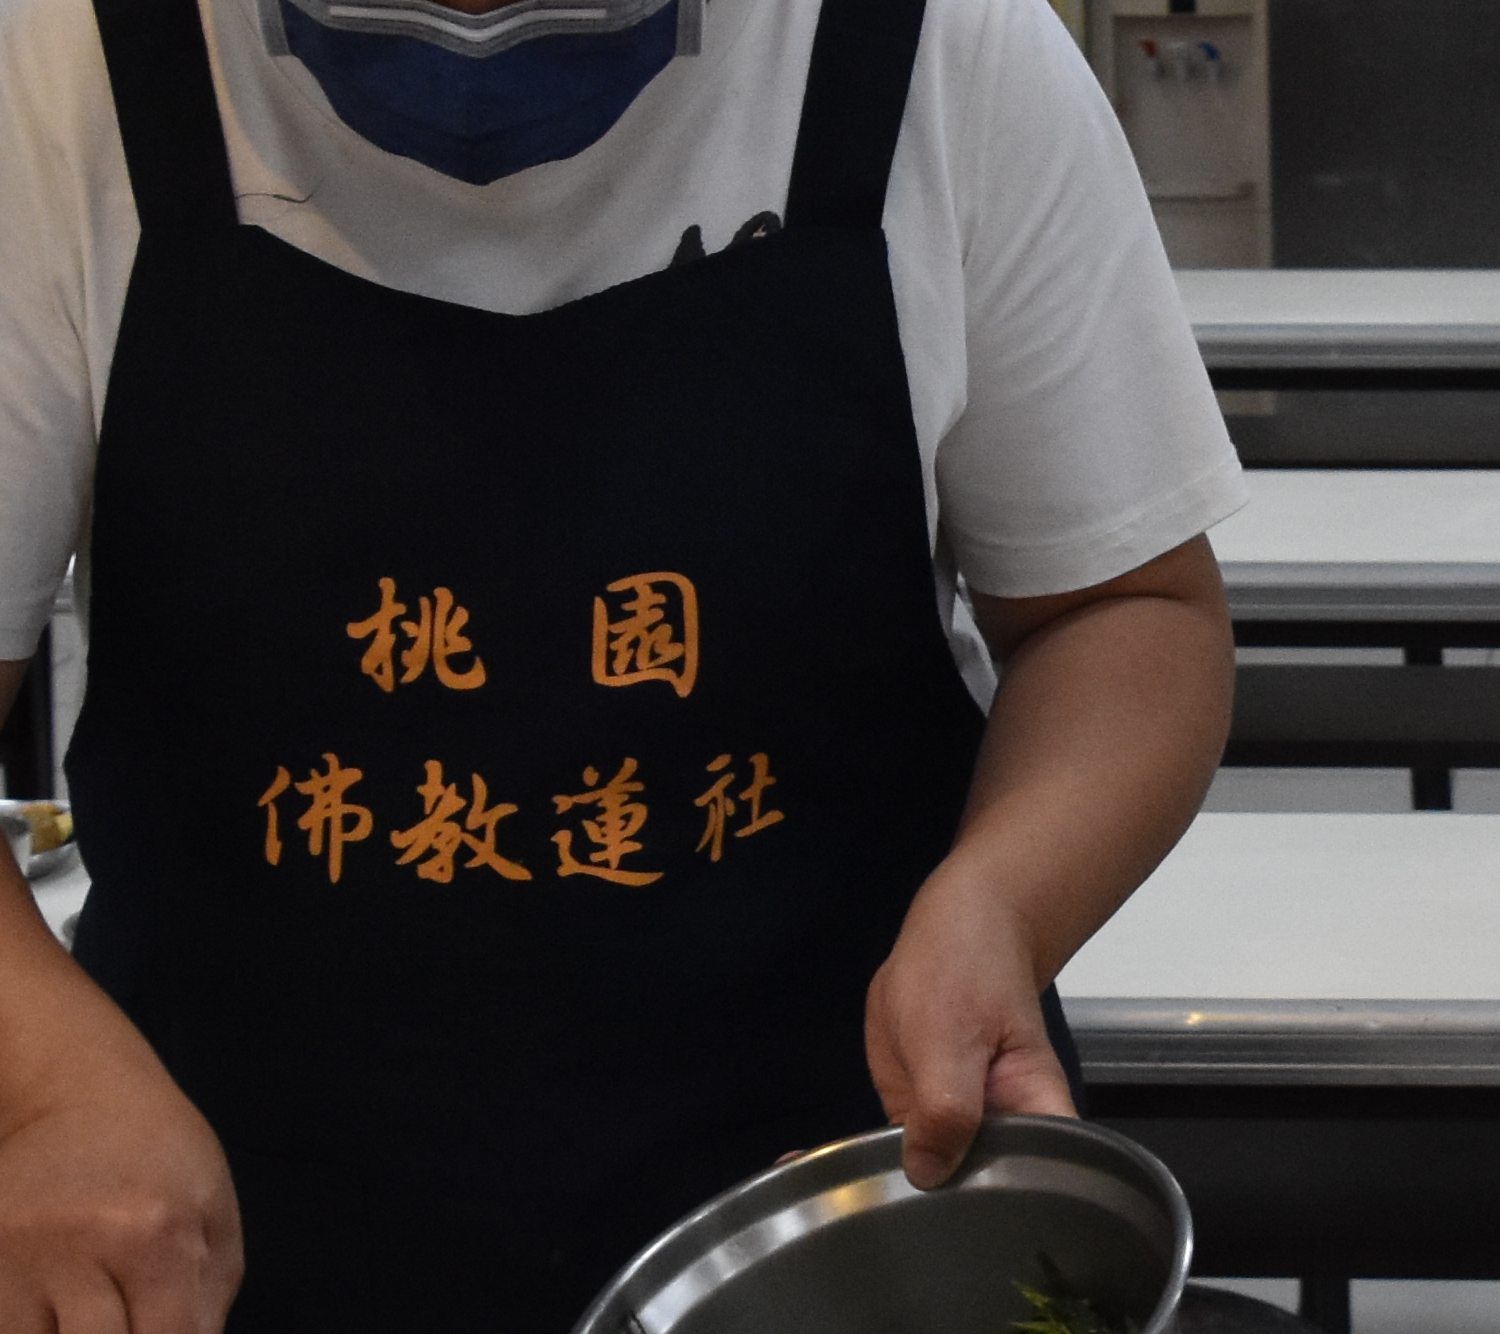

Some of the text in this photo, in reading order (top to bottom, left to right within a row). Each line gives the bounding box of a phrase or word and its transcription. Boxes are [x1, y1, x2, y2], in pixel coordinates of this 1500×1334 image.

[346, 570, 699, 699] 桃園
[257, 752, 785, 888] 佛教蓮社
